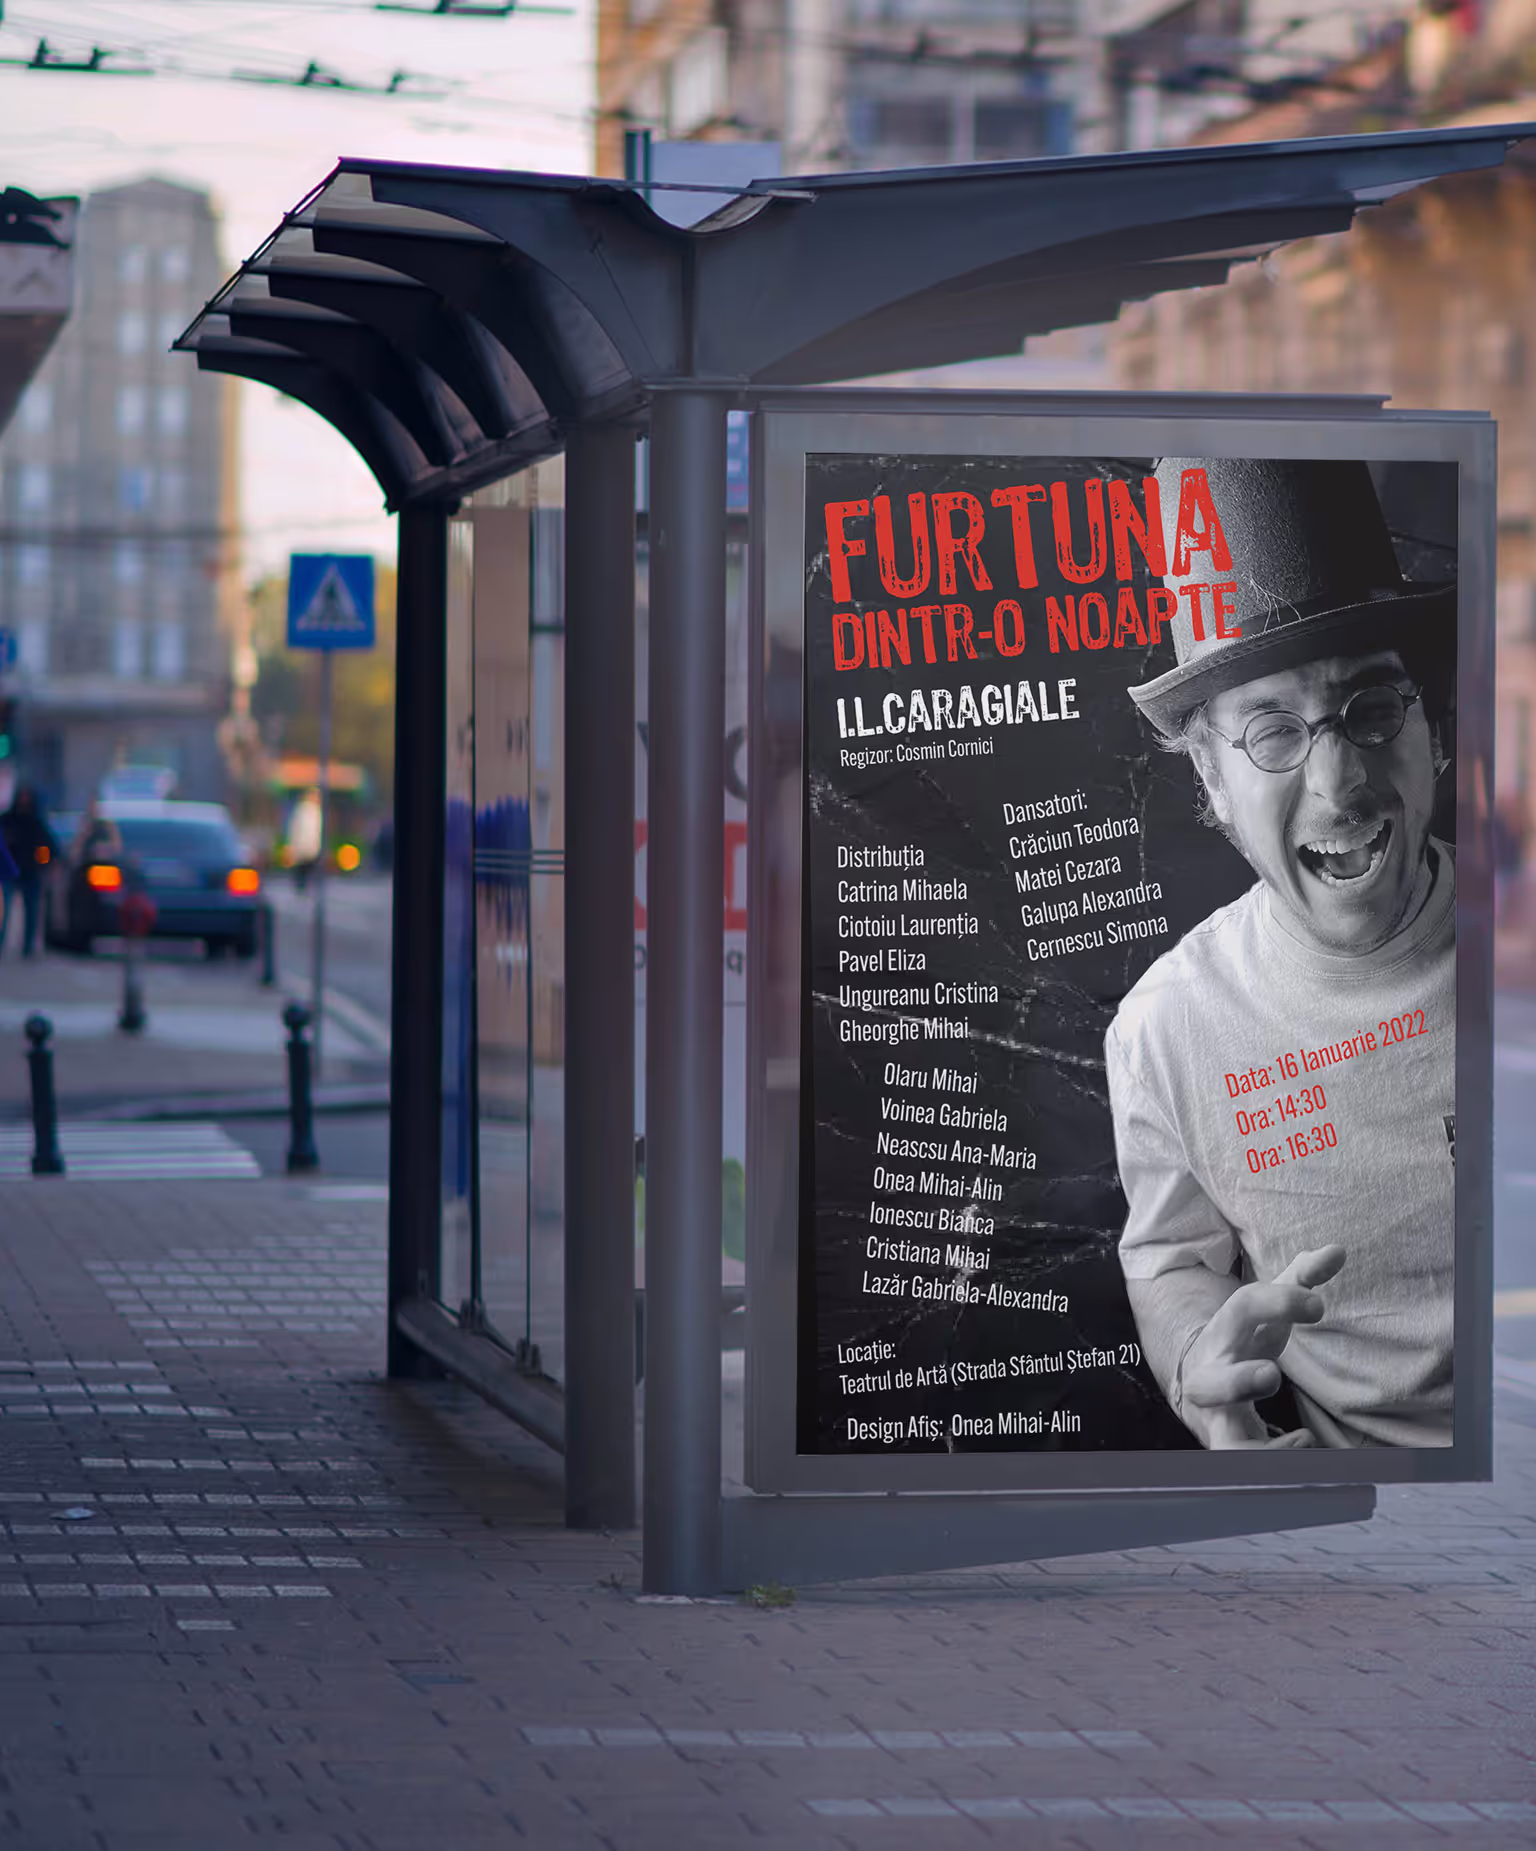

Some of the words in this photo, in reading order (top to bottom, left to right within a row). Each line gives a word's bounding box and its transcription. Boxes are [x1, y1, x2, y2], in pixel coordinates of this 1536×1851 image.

[825, 468, 1233, 603] FURTUNA
[832, 600, 1024, 671] DINTR-O
[1049, 581, 1243, 654] NOAPTE
[836, 678, 1080, 738] I.L.CARAGIALE
[840, 748, 893, 769] Regizor:
[896, 742, 945, 762] Cosmin
[948, 737, 993, 758] Cornici
[1003, 790, 1088, 826] Dansatori:
[1074, 816, 1139, 847] Teodora
[838, 880, 898, 903] Catrina
[903, 878, 967, 900] Mihaela
[1015, 863, 1062, 893] Matei
[1065, 855, 1122, 881] Cezara
[1021, 899, 1079, 927] Galupa
[1082, 882, 1162, 916] Alexandra
[838, 915, 895, 938] Ciotoiu
[1027, 929, 1104, 961] Cernescu
[1107, 916, 1168, 946] Simona
[839, 949, 883, 972] Pavel
[888, 949, 926, 971] Eliza
[839, 986, 930, 1011] Ungureanu
[934, 982, 999, 1004] Cristina
[840, 1019, 919, 1045] Gheorghe
[923, 1017, 969, 1040] Mihai
[1224, 1065, 1276, 1099] Data:
[1276, 1053, 1299, 1081] 16
[1300, 1030, 1377, 1073] Ianuarie
[1378, 1009, 1429, 1047] 2022
[884, 1062, 928, 1088] Olaru
[932, 1067, 978, 1094] Mihai
[881, 1097, 935, 1125] Voinea
[939, 1103, 1008, 1132] Gabriela
[1236, 1106, 1275, 1136] Ora:
[1275, 1085, 1327, 1122] 14:30
[877, 1132, 947, 1161] Neascsu
[950, 1140, 1037, 1169] Ana-Maria
[1246, 1144, 1285, 1174] Ora:
[1286, 1122, 1337, 1160] 16:30
[873, 1167, 915, 1192] Onea
[919, 1171, 1002, 1201] Mihai-Alin
[869, 1202, 934, 1230] Ionescu
[938, 1208, 994, 1235] Bianca
[866, 1236, 940, 1265] Cristiana
[945, 1243, 990, 1270] Mihai
[912, 1275, 1069, 1312] Gabriela-Alexandra
[840, 1371, 892, 1394] Teatrul
[895, 1369, 913, 1388] de
[951, 1358, 1006, 1386] (Strada
[1010, 1352, 1063, 1377] Sfântul
[1119, 1343, 1141, 1366] 21)
[848, 1416, 903, 1443] Design
[952, 1414, 993, 1436] Onea
[998, 1411, 1081, 1434] Mihai-Alin
